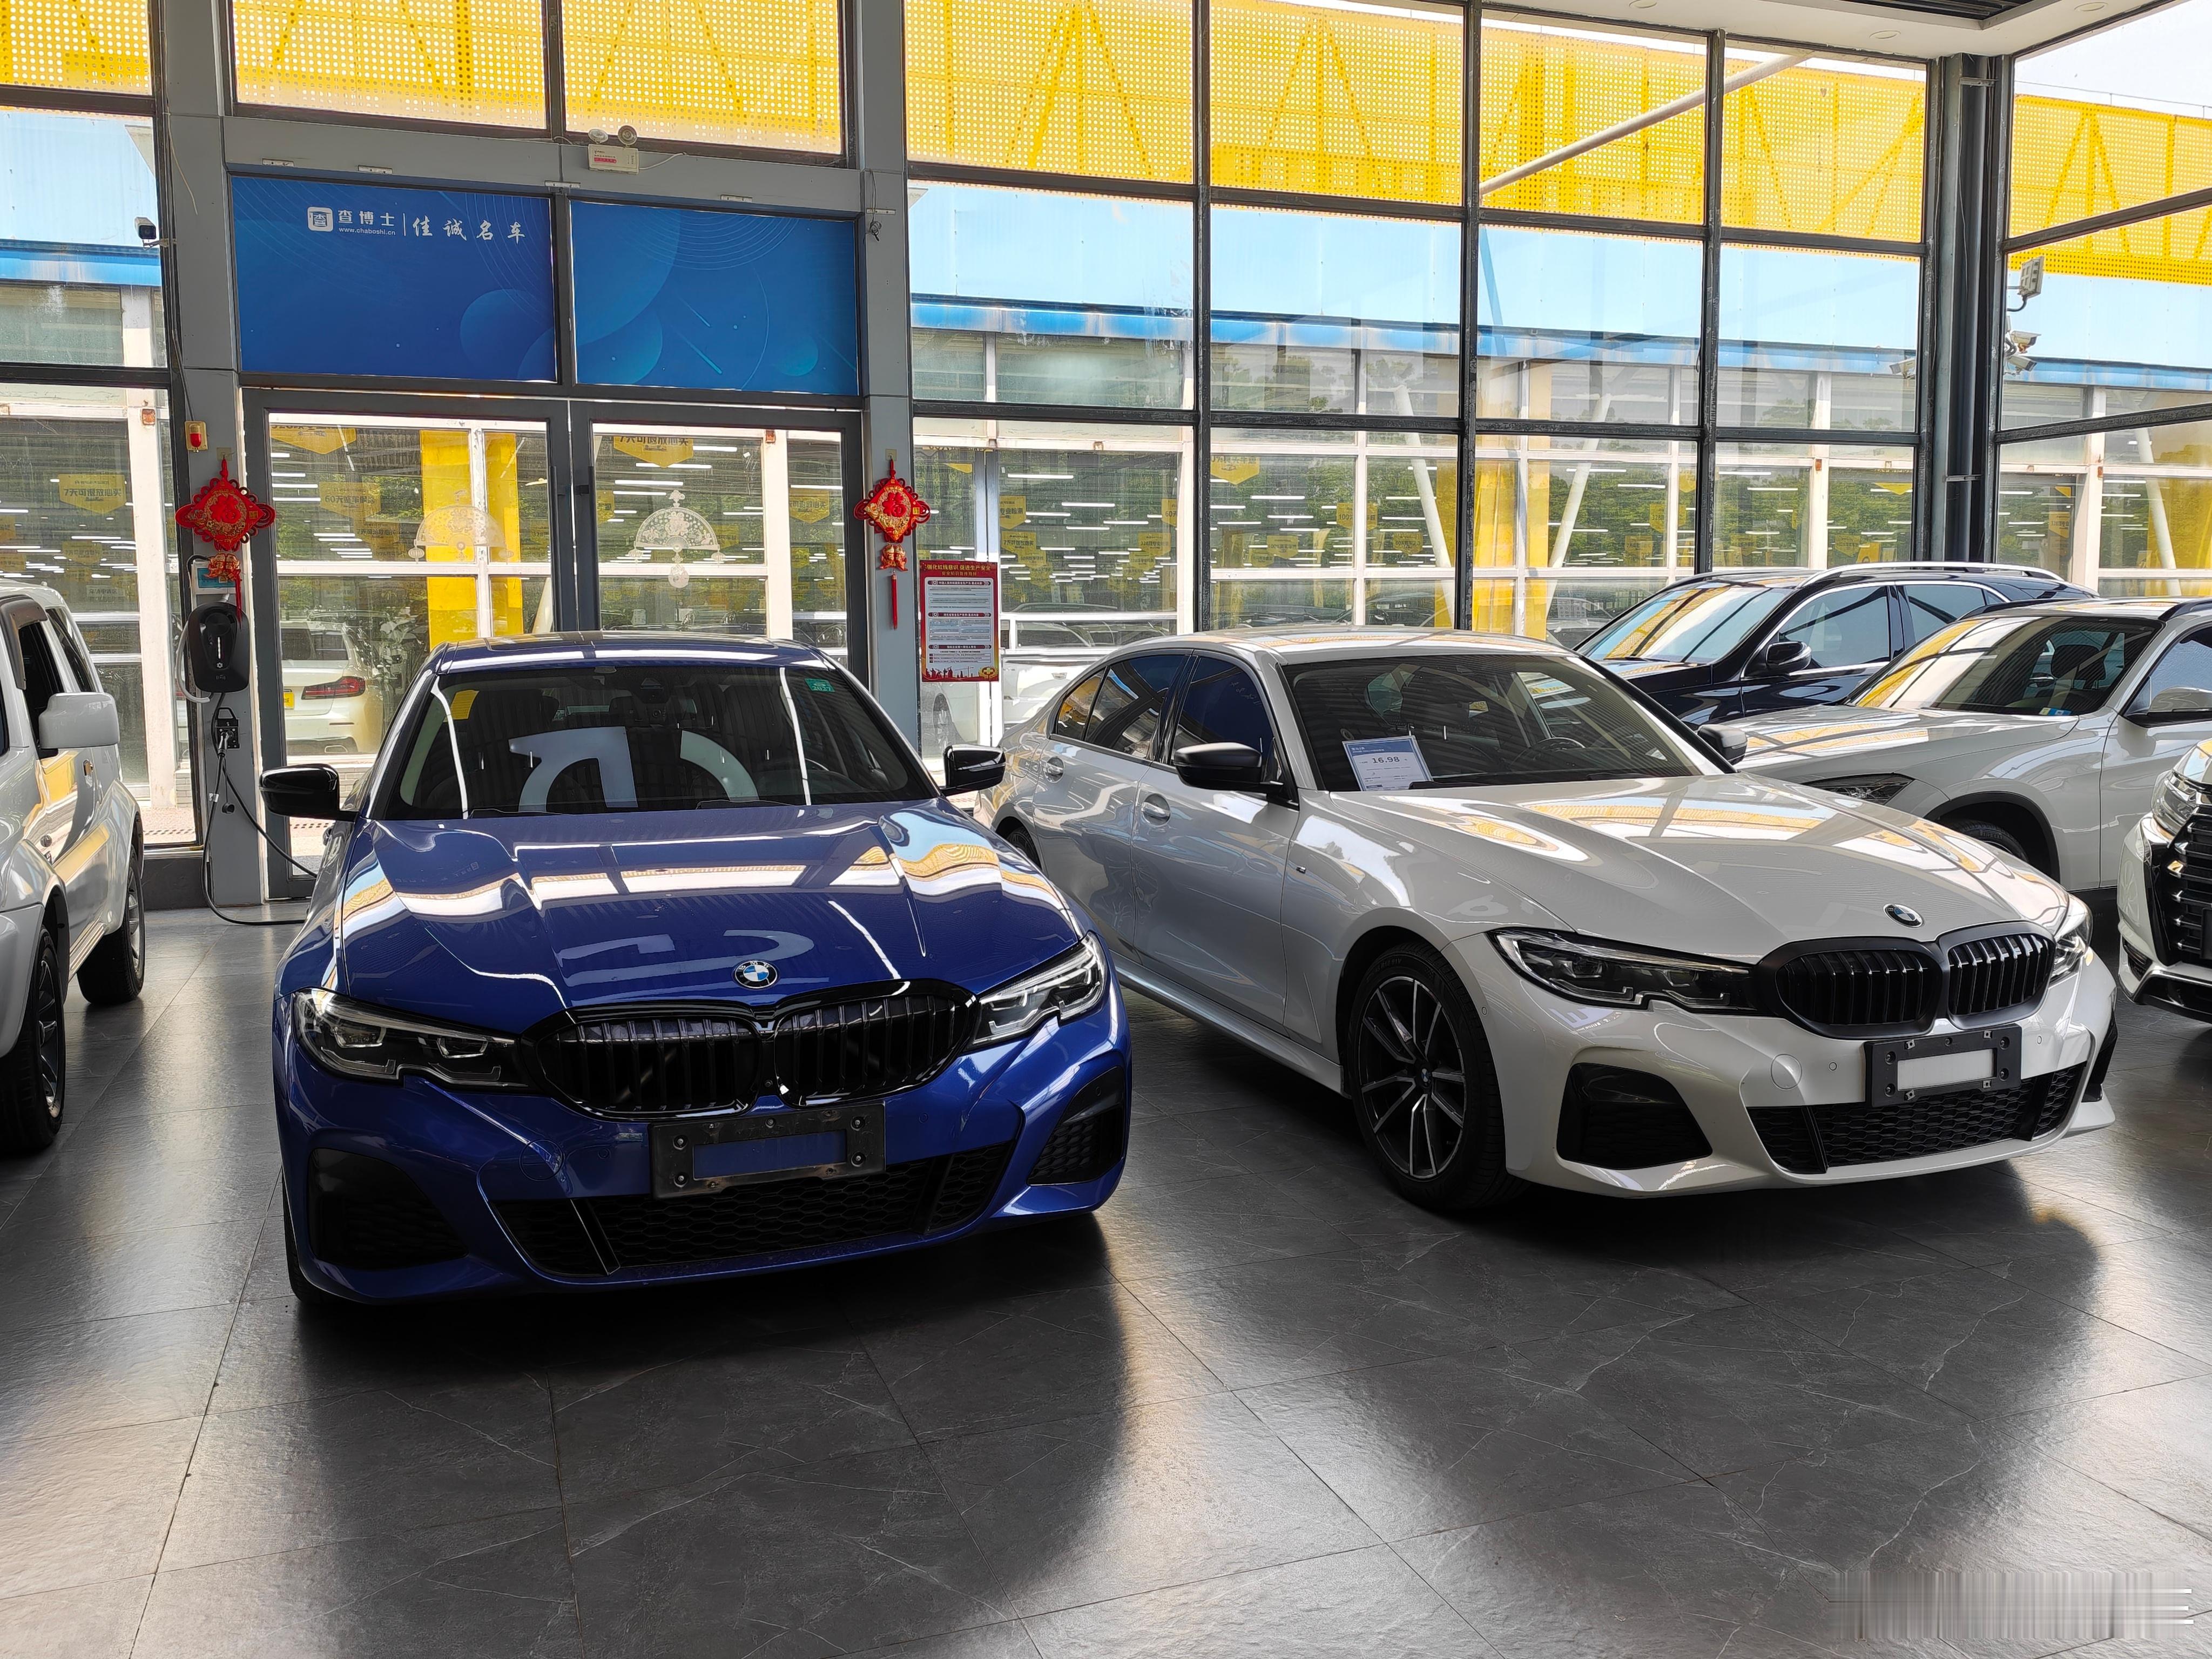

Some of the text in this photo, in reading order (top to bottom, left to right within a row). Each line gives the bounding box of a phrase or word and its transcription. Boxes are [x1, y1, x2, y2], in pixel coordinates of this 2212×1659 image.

[338, 210, 395, 226] 查博士
[413, 215, 525, 244] 佳诚名车
